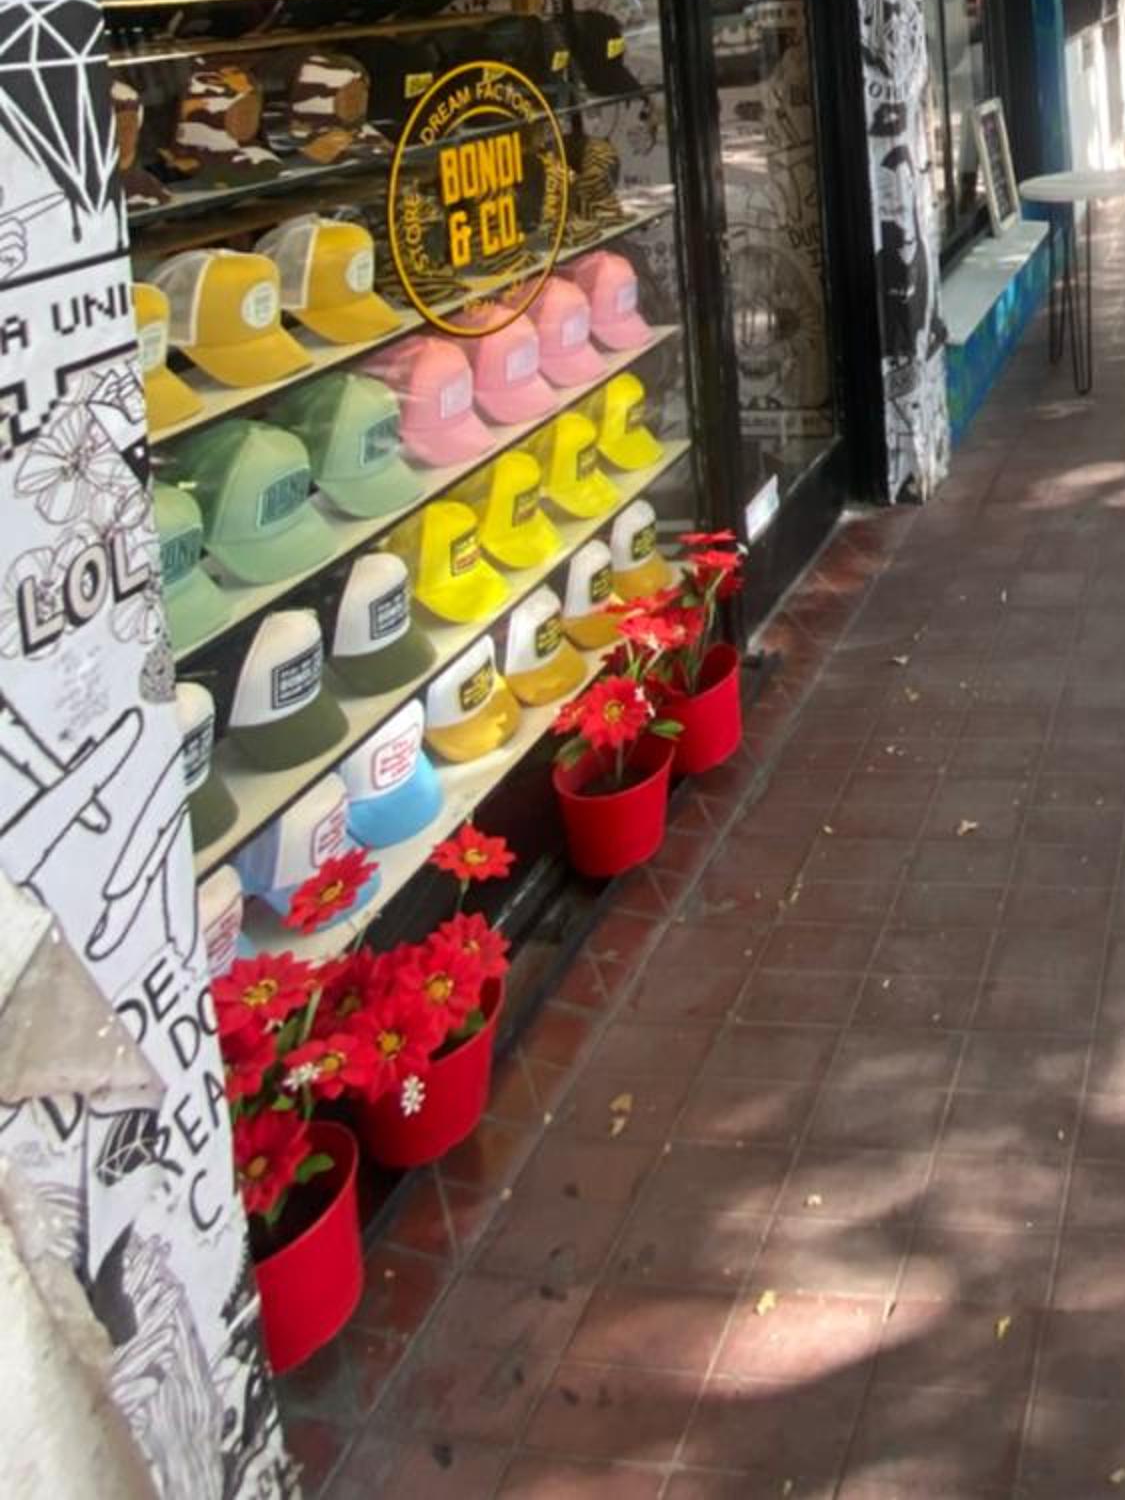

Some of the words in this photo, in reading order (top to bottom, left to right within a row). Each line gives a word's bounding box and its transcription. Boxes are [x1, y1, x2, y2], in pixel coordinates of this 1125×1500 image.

[419, 85, 472, 147] DREAM
[440, 131, 524, 205] BONDI
[449, 210, 472, 268] &
[51, 282, 129, 336] UNI
[17, 530, 150, 656] LOL
